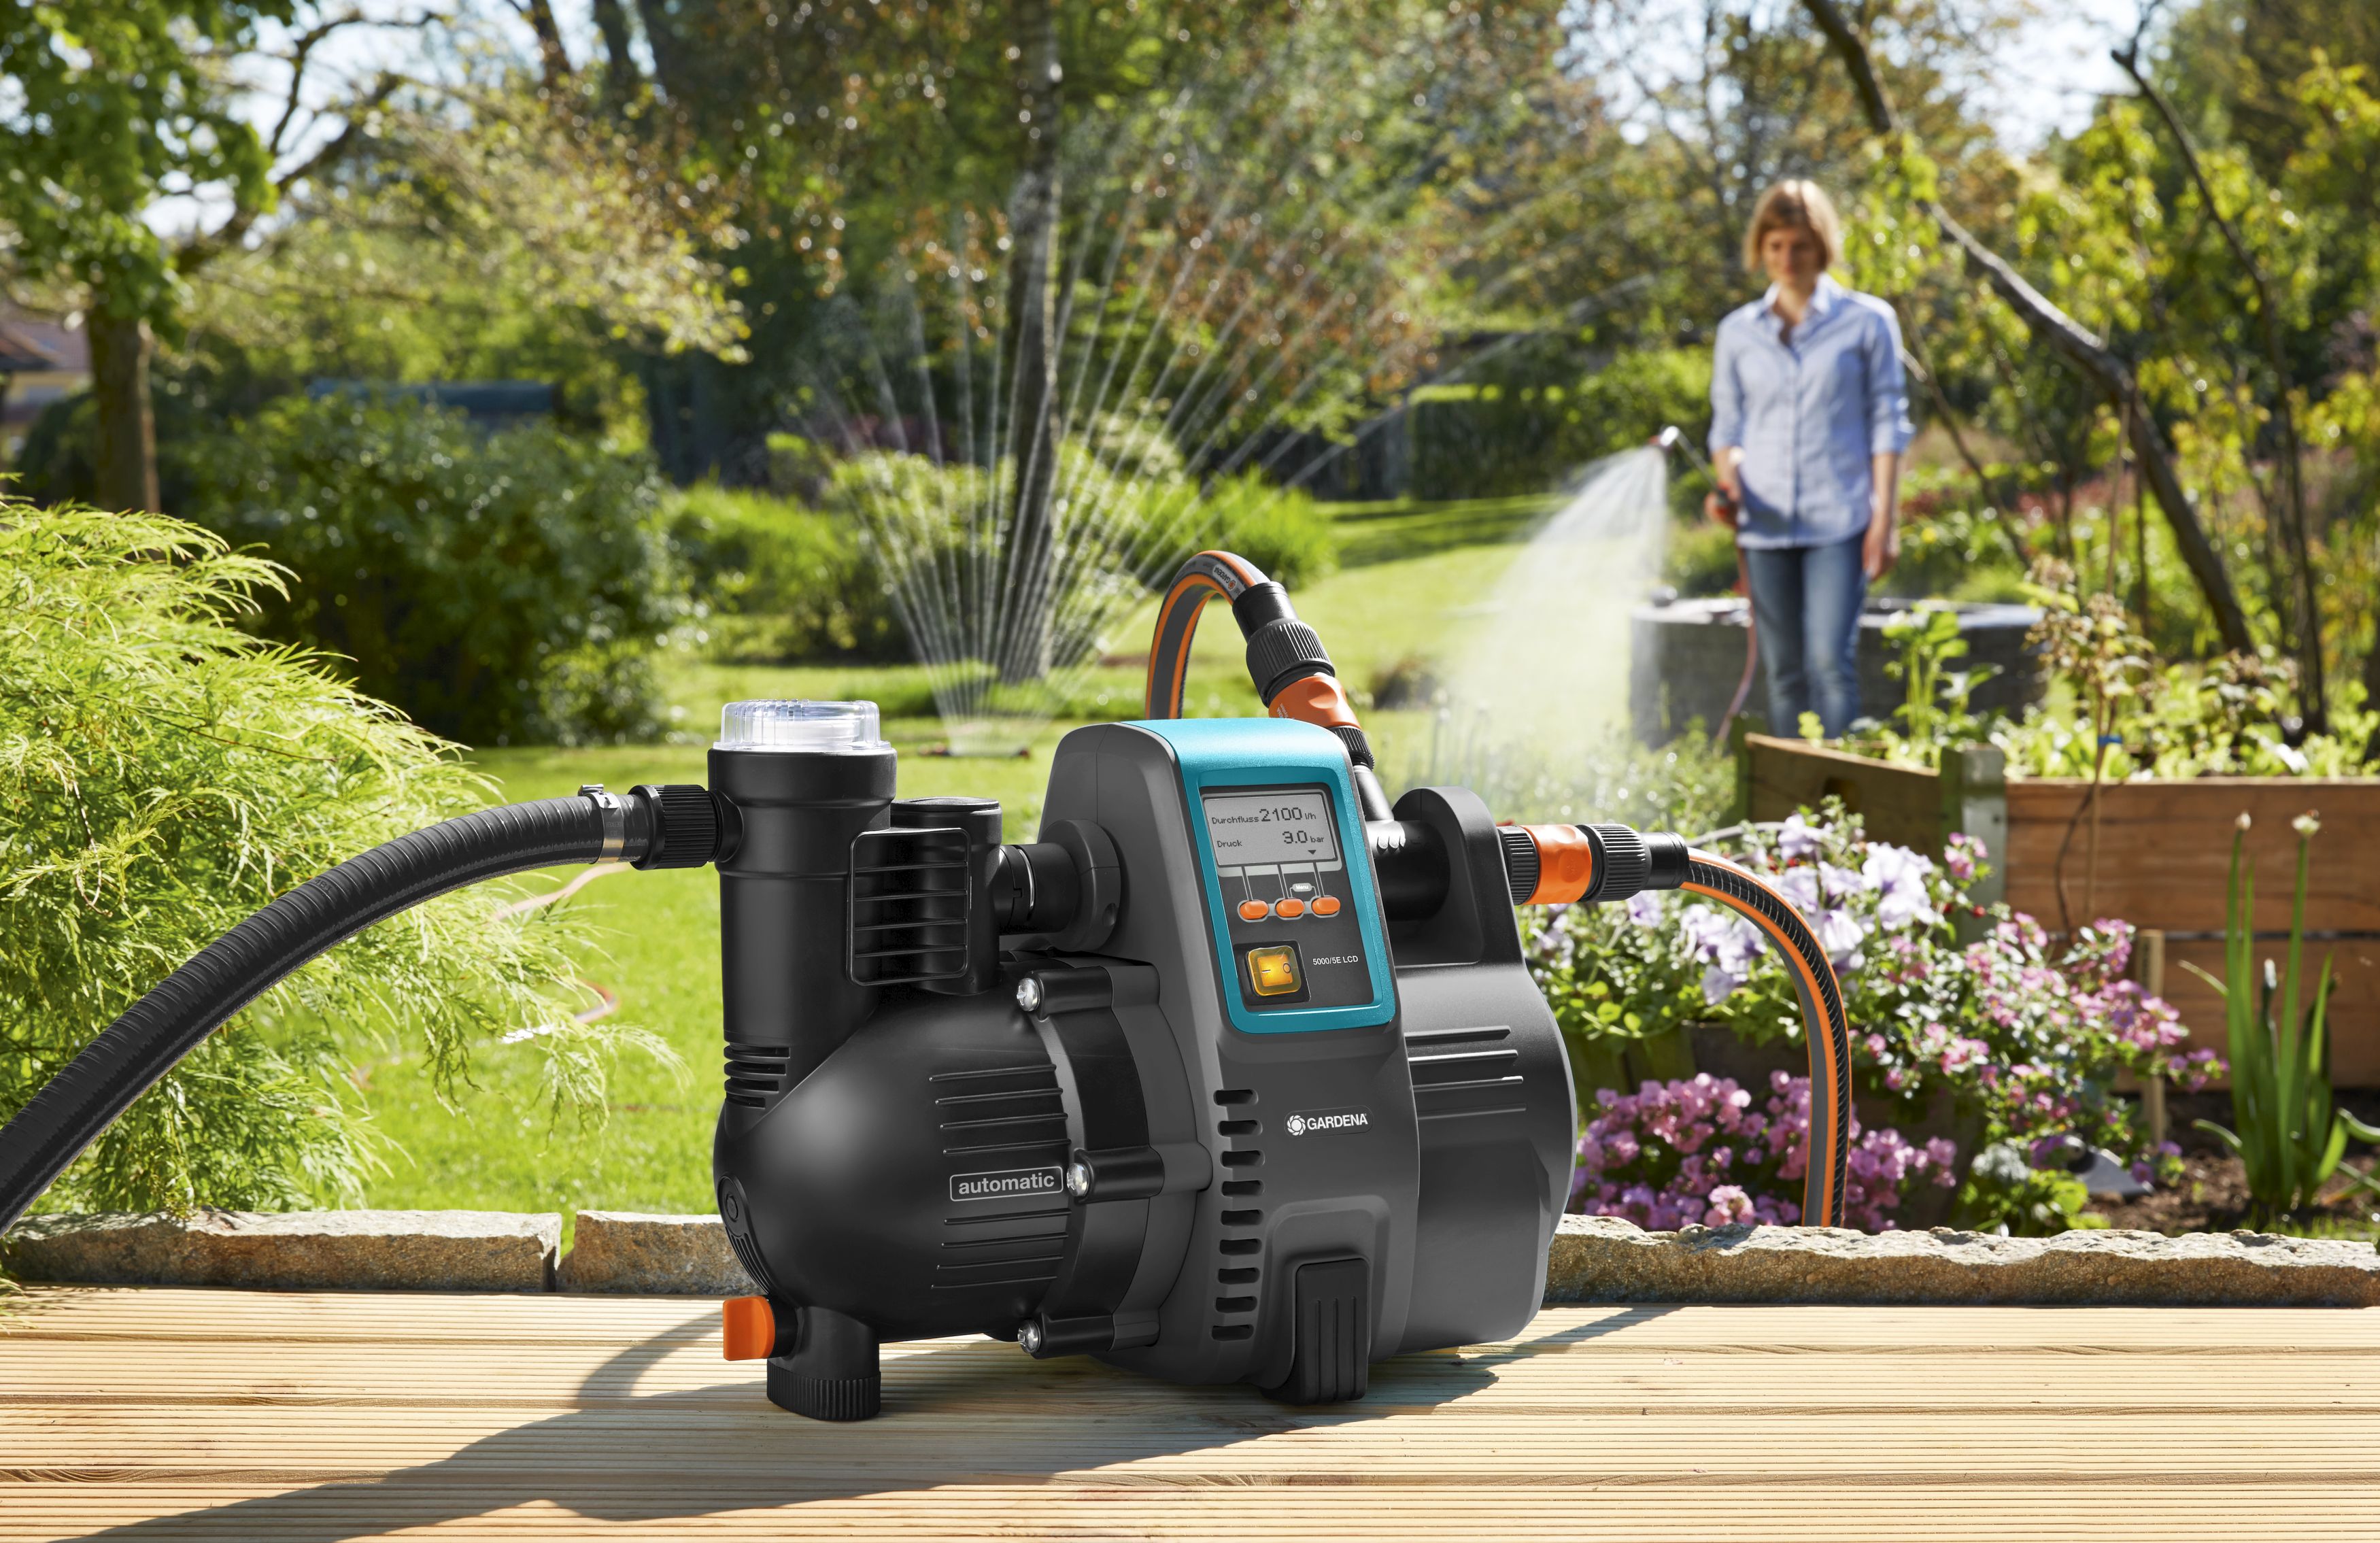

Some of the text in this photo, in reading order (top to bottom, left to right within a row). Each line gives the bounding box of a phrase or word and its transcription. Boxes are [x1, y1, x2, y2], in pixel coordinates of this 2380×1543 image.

[1213, 567, 1231, 584] GARDENA
[1211, 815, 1259, 825] Durchfluss
[1259, 807, 1303, 822] 2100
[1217, 839, 1243, 848] Druck
[1282, 830, 1308, 845] 3.0
[1312, 955, 1359, 966] 5000/5E LCD
[1306, 1113, 1368, 1130] GARDENA
[958, 1172, 1055, 1195] automatic
